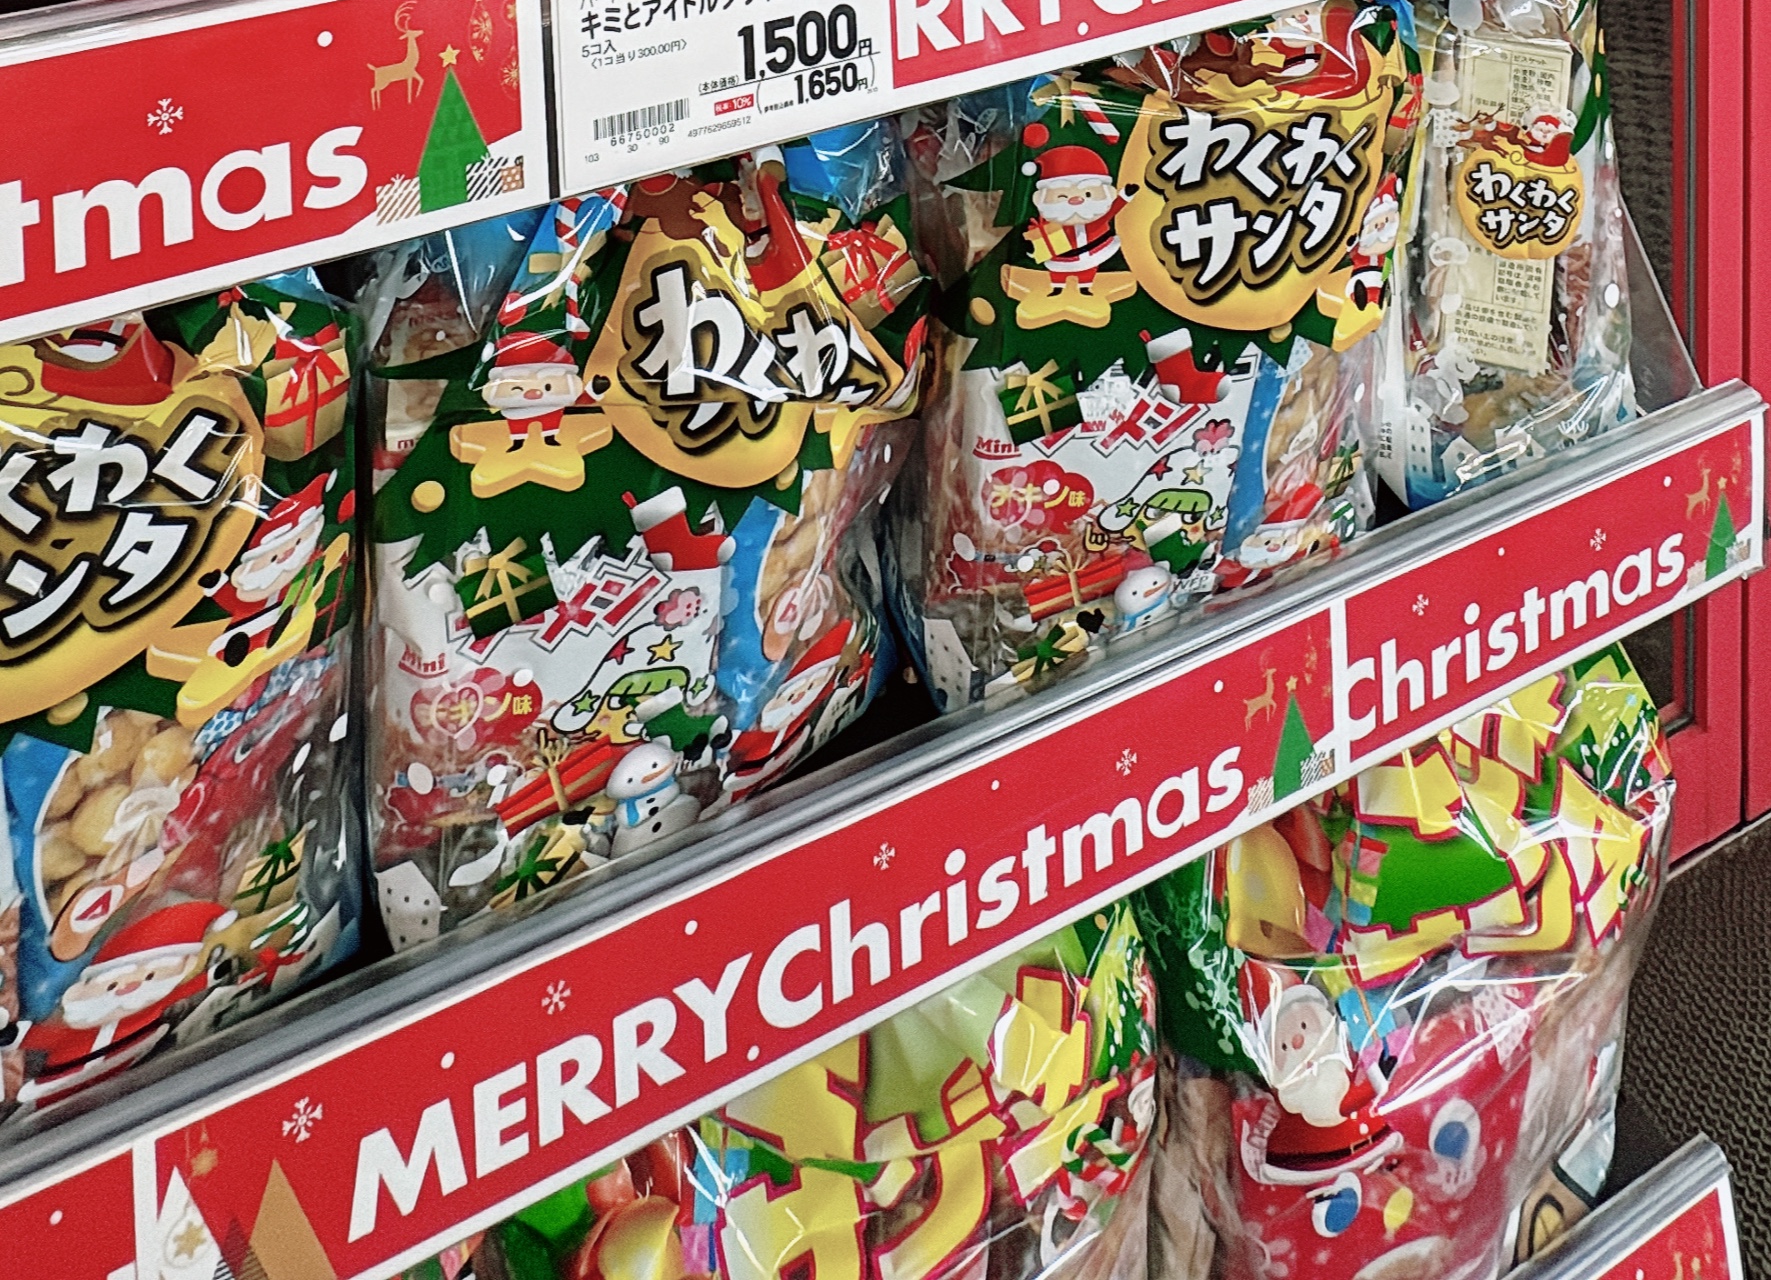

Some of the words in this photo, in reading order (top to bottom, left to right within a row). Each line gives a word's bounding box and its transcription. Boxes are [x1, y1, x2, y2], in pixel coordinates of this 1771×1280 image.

[581, 39, 617, 58] 5コ入
[610, 123, 675, 147] 66750002
[1161, 107, 1368, 198] わくわく
[1472, 162, 1577, 215] わくわく
[1481, 207, 1567, 241] サンタ
[1166, 181, 1342, 286] サンタ
[1347, 532, 1686, 742] Christmas
[348, 952, 754, 1242] MERRY
[755, 745, 1245, 1030] Christmas
